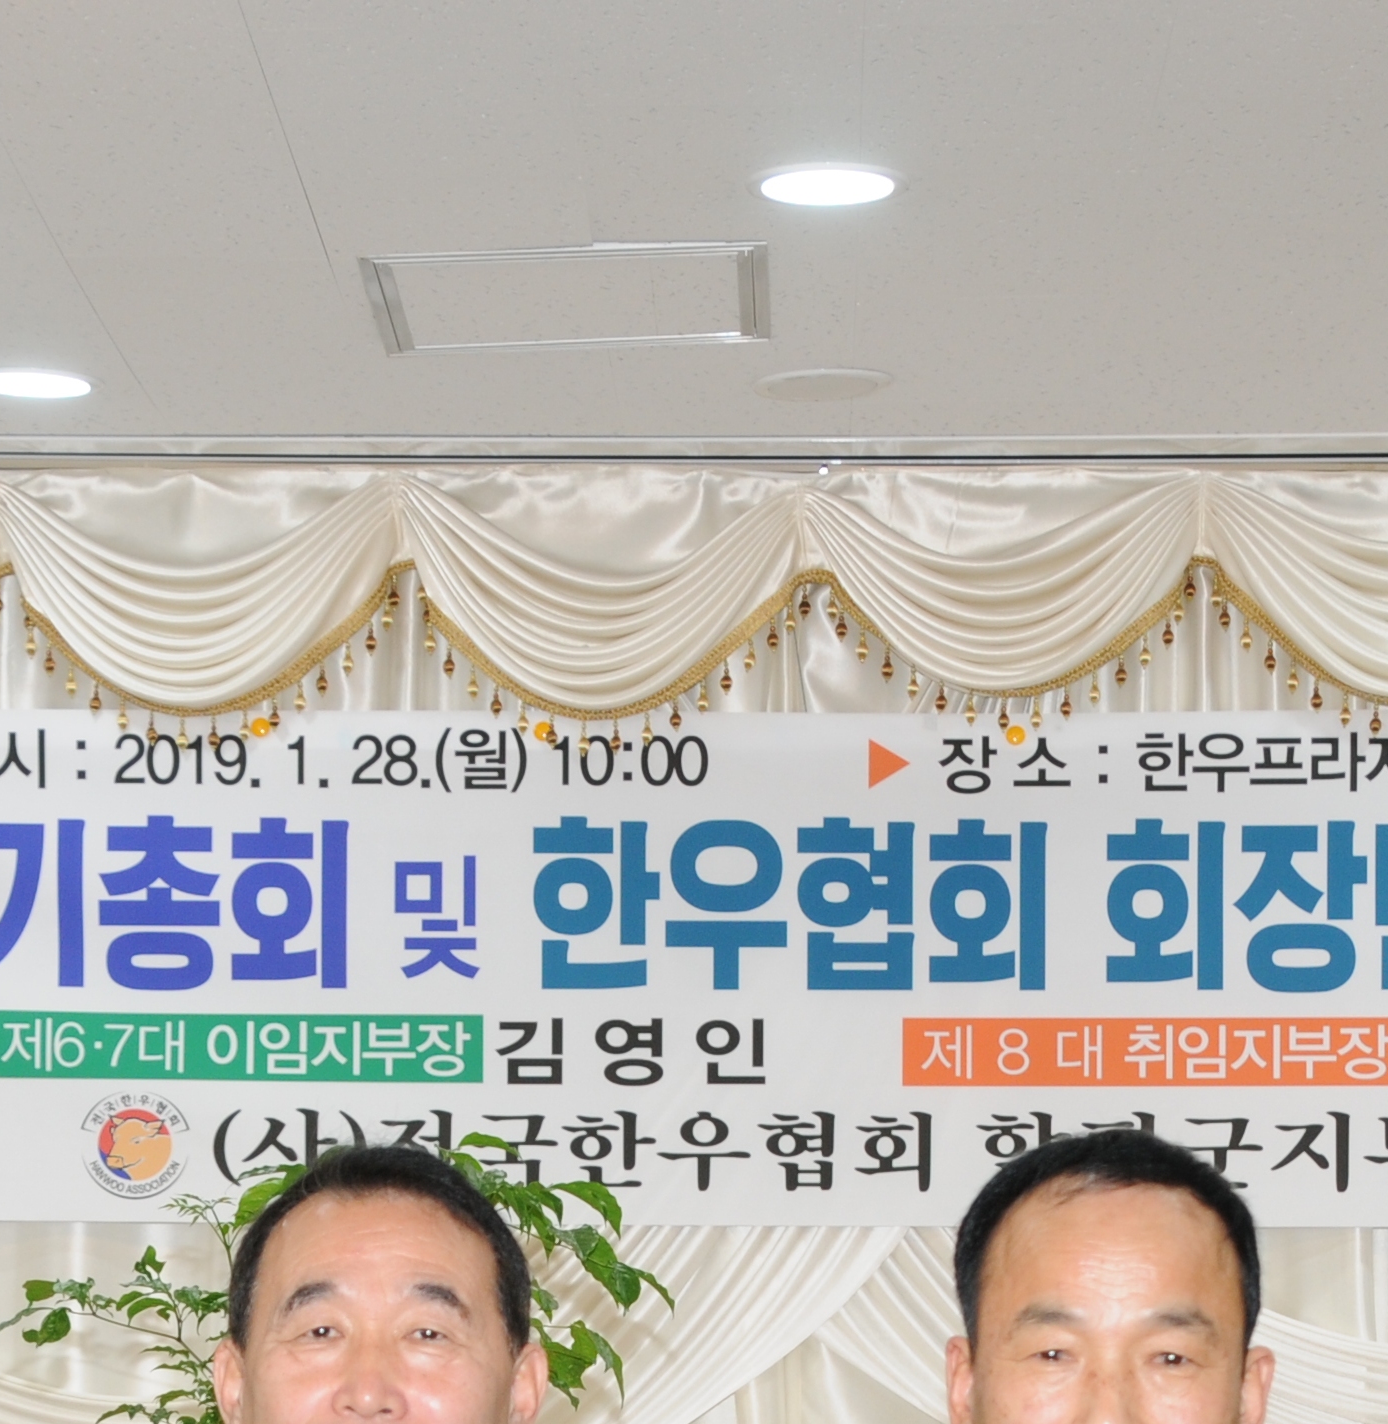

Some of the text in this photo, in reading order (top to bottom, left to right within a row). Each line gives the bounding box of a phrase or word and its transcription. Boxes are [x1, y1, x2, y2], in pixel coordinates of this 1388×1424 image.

[114, 734, 261, 788] 2019.
[287, 736, 329, 789] 1.
[553, 735, 709, 787] 10:00
[395, 855, 479, 979] 및
[533, 816, 1048, 991] 한우협회
[0, 1017, 471, 1077] 제6·7대 이임지부장
[88, 1159, 181, 1195] HANWOO ASSOCIATION
